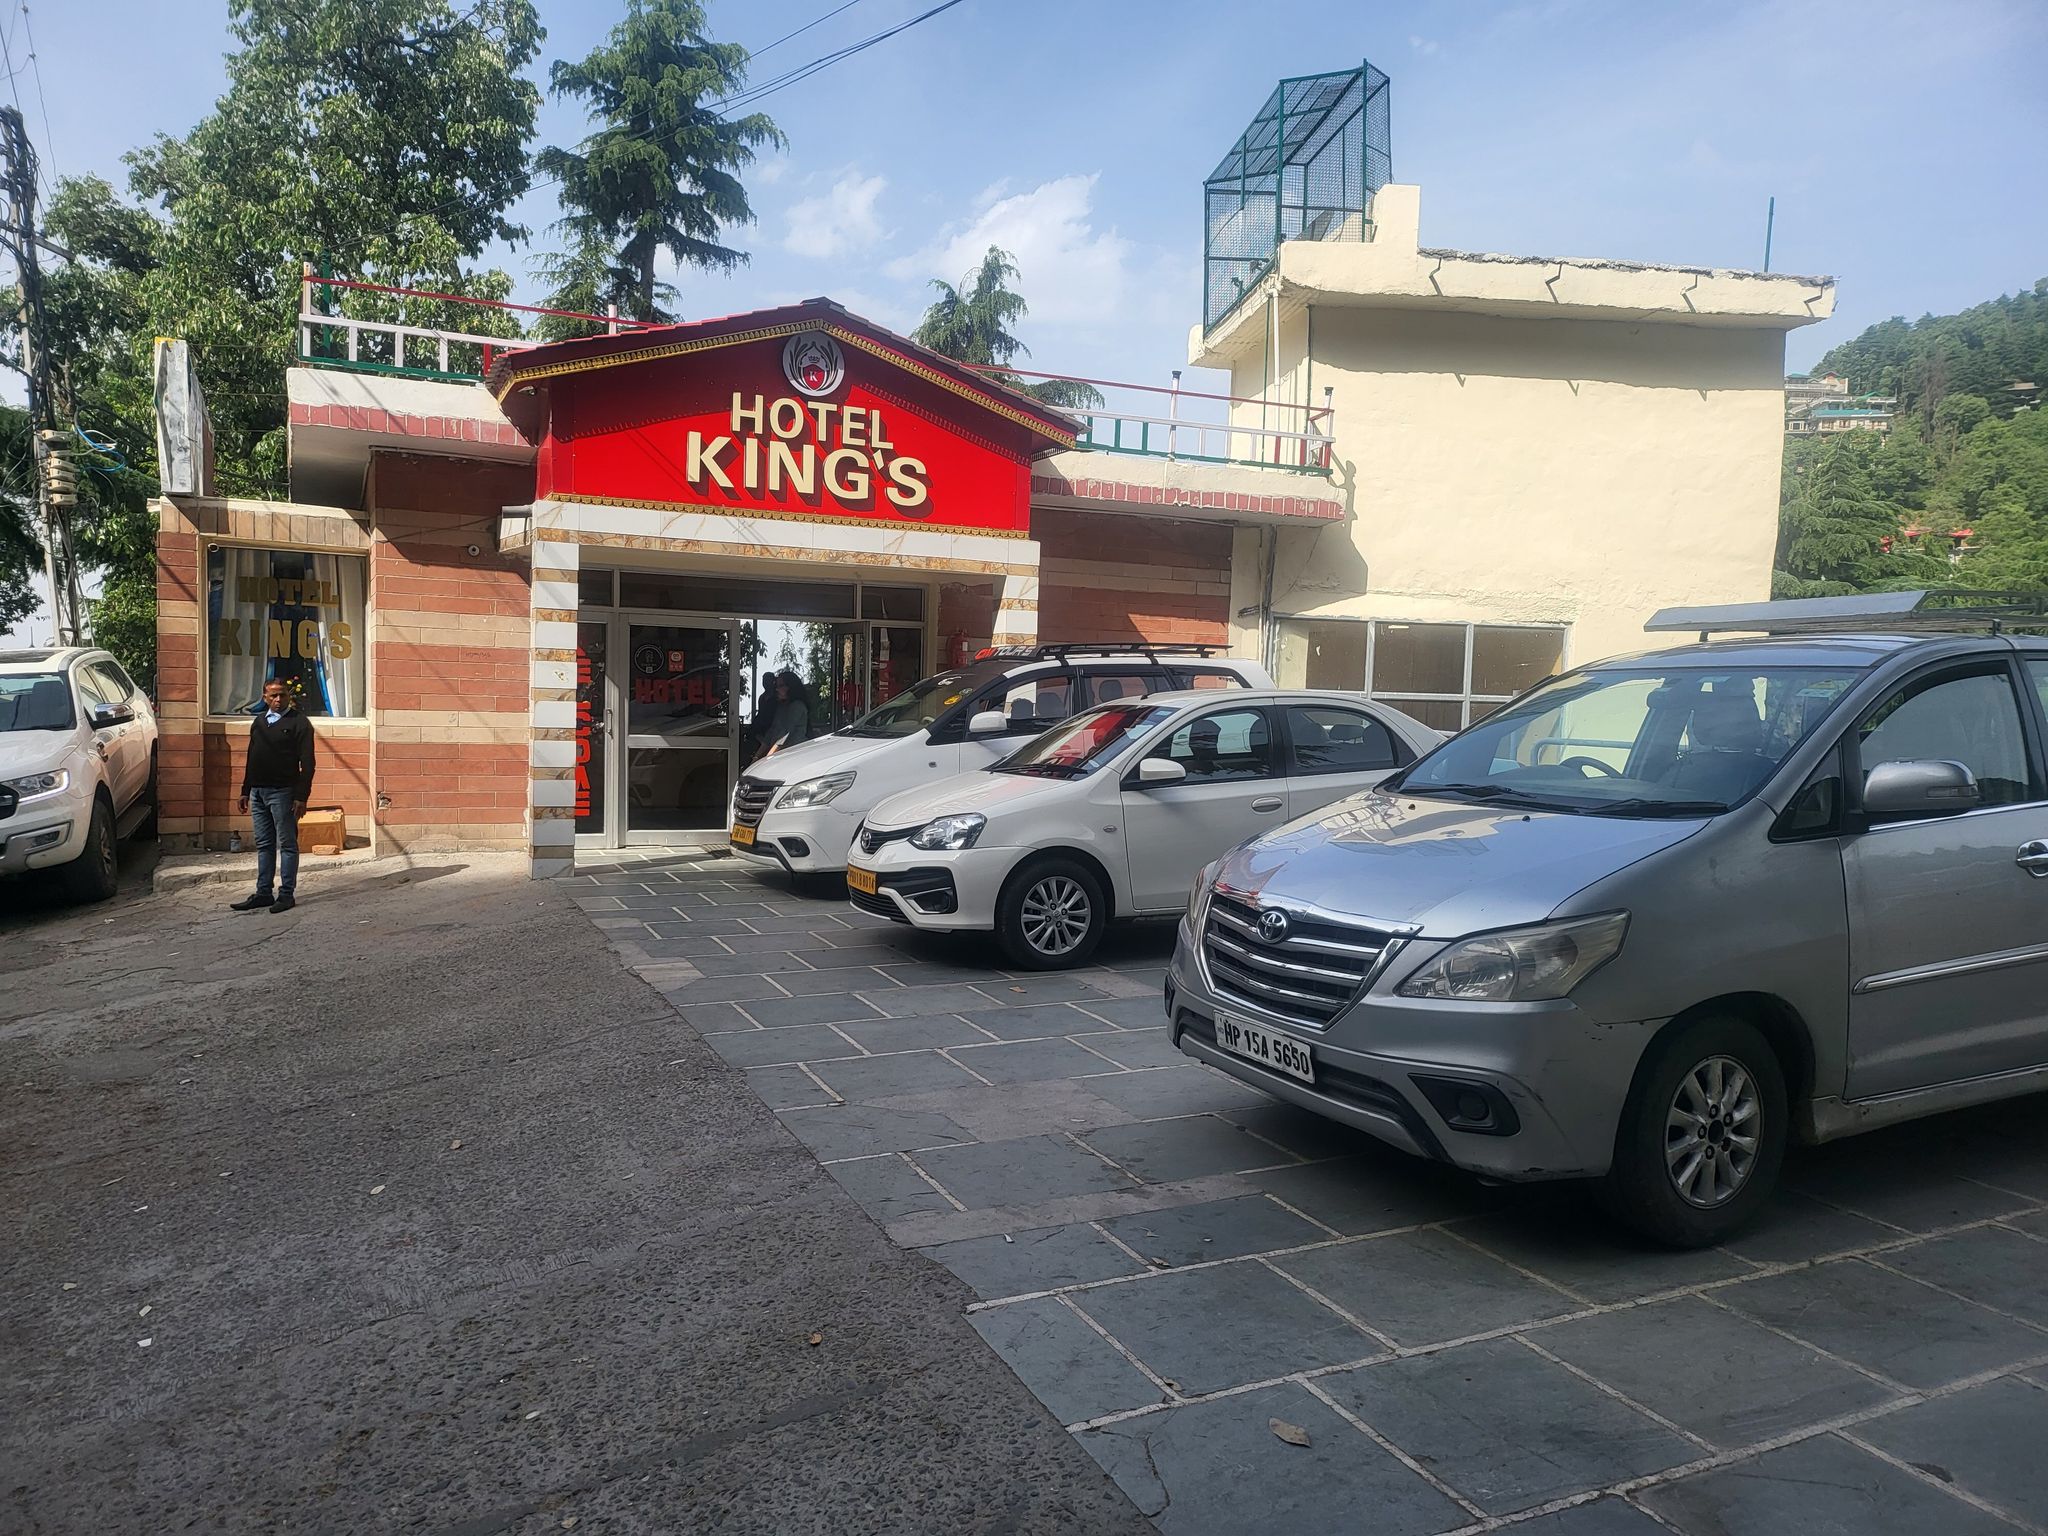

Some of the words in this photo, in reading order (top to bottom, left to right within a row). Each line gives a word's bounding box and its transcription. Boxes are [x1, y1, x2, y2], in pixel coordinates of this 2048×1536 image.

[809, 371, 818, 382] K
[731, 391, 894, 450] HOTEL
[686, 430, 929, 508] KING'S
[238, 576, 340, 608] HOTEL
[219, 618, 353, 660] KINGS
[993, 646, 1037, 657] TOURS
[635, 677, 720, 706] HOTEL
[1223, 1021, 1241, 1047] HP
[1244, 1029, 1269, 1060] 15A
[1273, 1039, 1310, 1076] 5650
